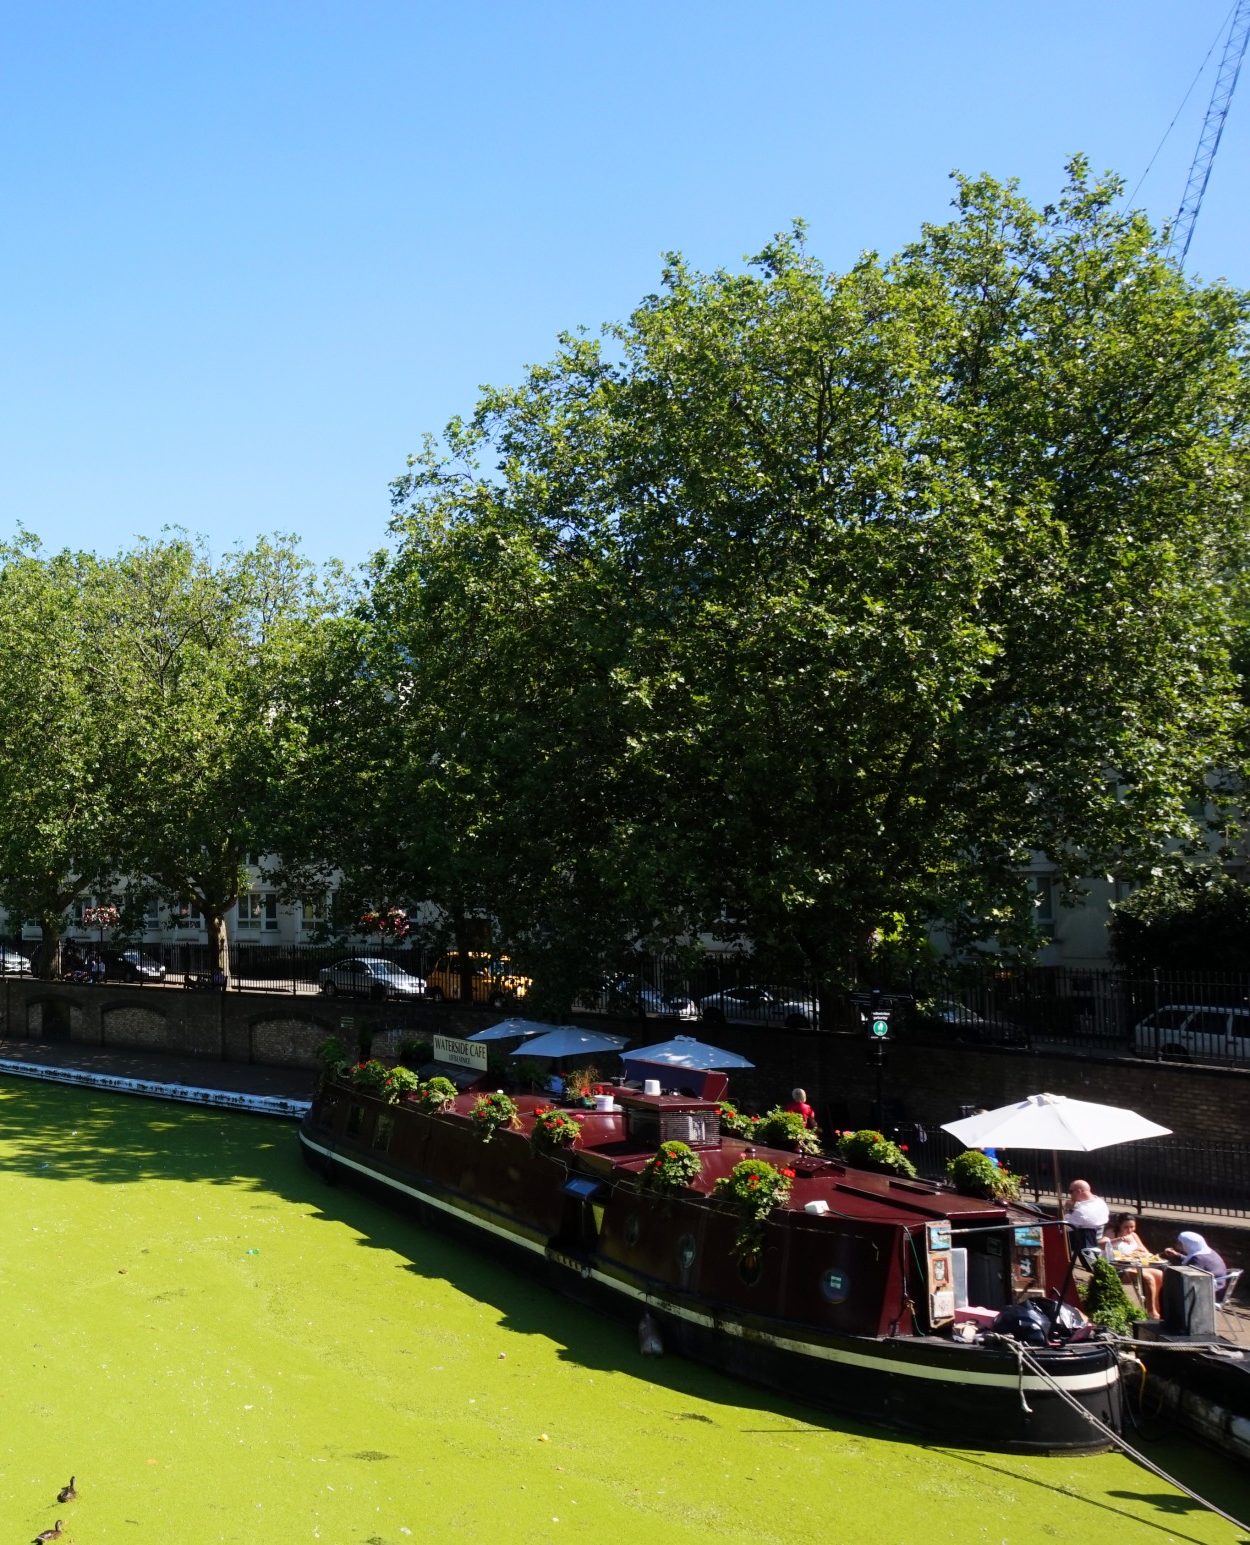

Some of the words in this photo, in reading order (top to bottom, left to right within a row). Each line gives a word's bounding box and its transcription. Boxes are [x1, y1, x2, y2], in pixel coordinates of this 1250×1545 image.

[435, 1037, 469, 1055] WATERSIDE
[470, 1044, 486, 1059] CAFE
[449, 1054, 458, 1062] LITTLE
